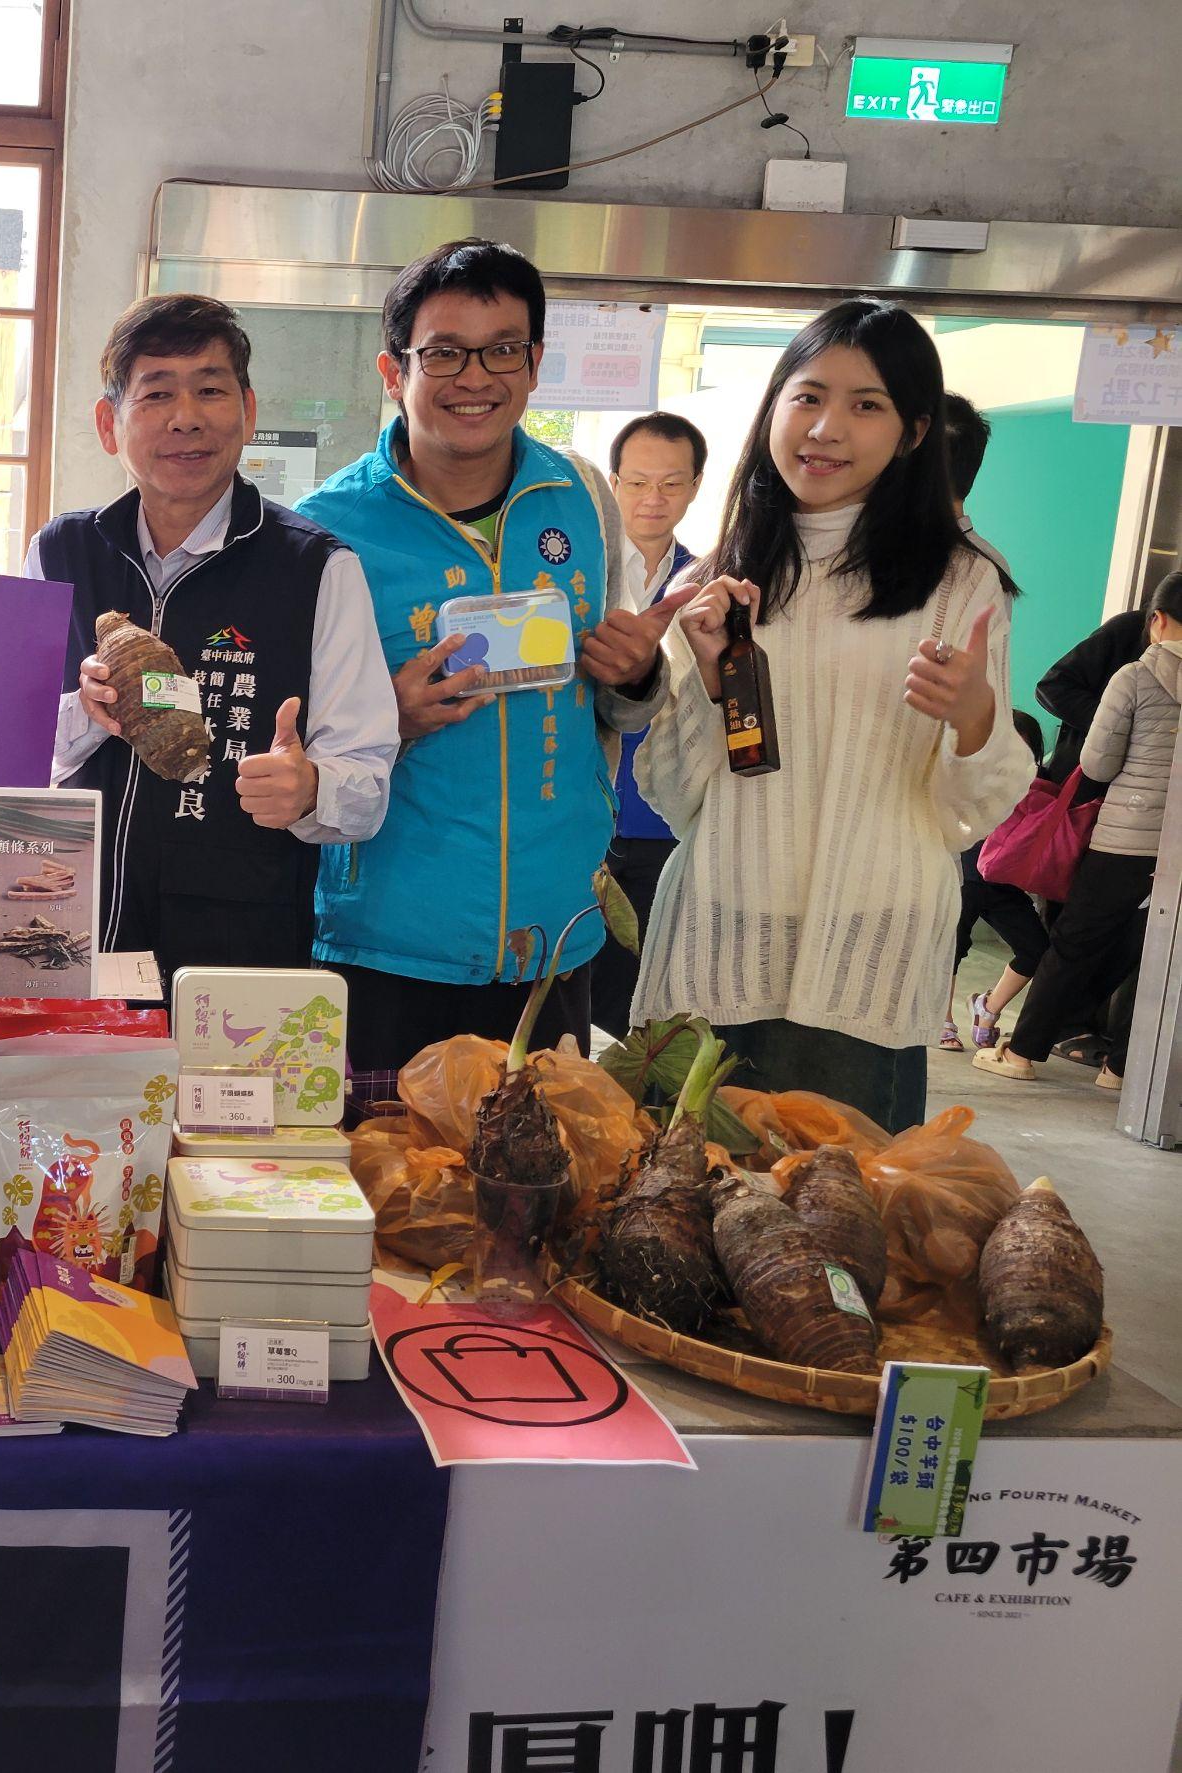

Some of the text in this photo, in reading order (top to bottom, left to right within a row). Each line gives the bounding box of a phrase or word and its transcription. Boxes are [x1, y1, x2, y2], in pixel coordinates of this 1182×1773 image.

[853, 95, 901, 110] EXIT
[941, 98, 996, 115] 緊急出口
[201, 649, 256, 665] 臺中市政府
[206, 670, 226, 709] 簡任
[222, 674, 257, 763] 農業局
[194, 993, 212, 1039] 阿聰師
[228, 1112, 245, 1121] 360
[18, 1119, 33, 1160] 阿聰師
[236, 1341, 248, 1371] 阿聰師
[267, 1346, 298, 1357] 草莓雪Q
[277, 1374, 295, 1385] 300
[890, 1414, 918, 1486] $100/袋
[916, 1415, 946, 1489] 台中芋頭
[1000, 1489, 1069, 1504] FOURTH
[1073, 1494, 1143, 1526] MARKET
[882, 1531, 1138, 1588] 第四市場
[934, 1592, 1072, 1607] CAFE & EXHIBITION
